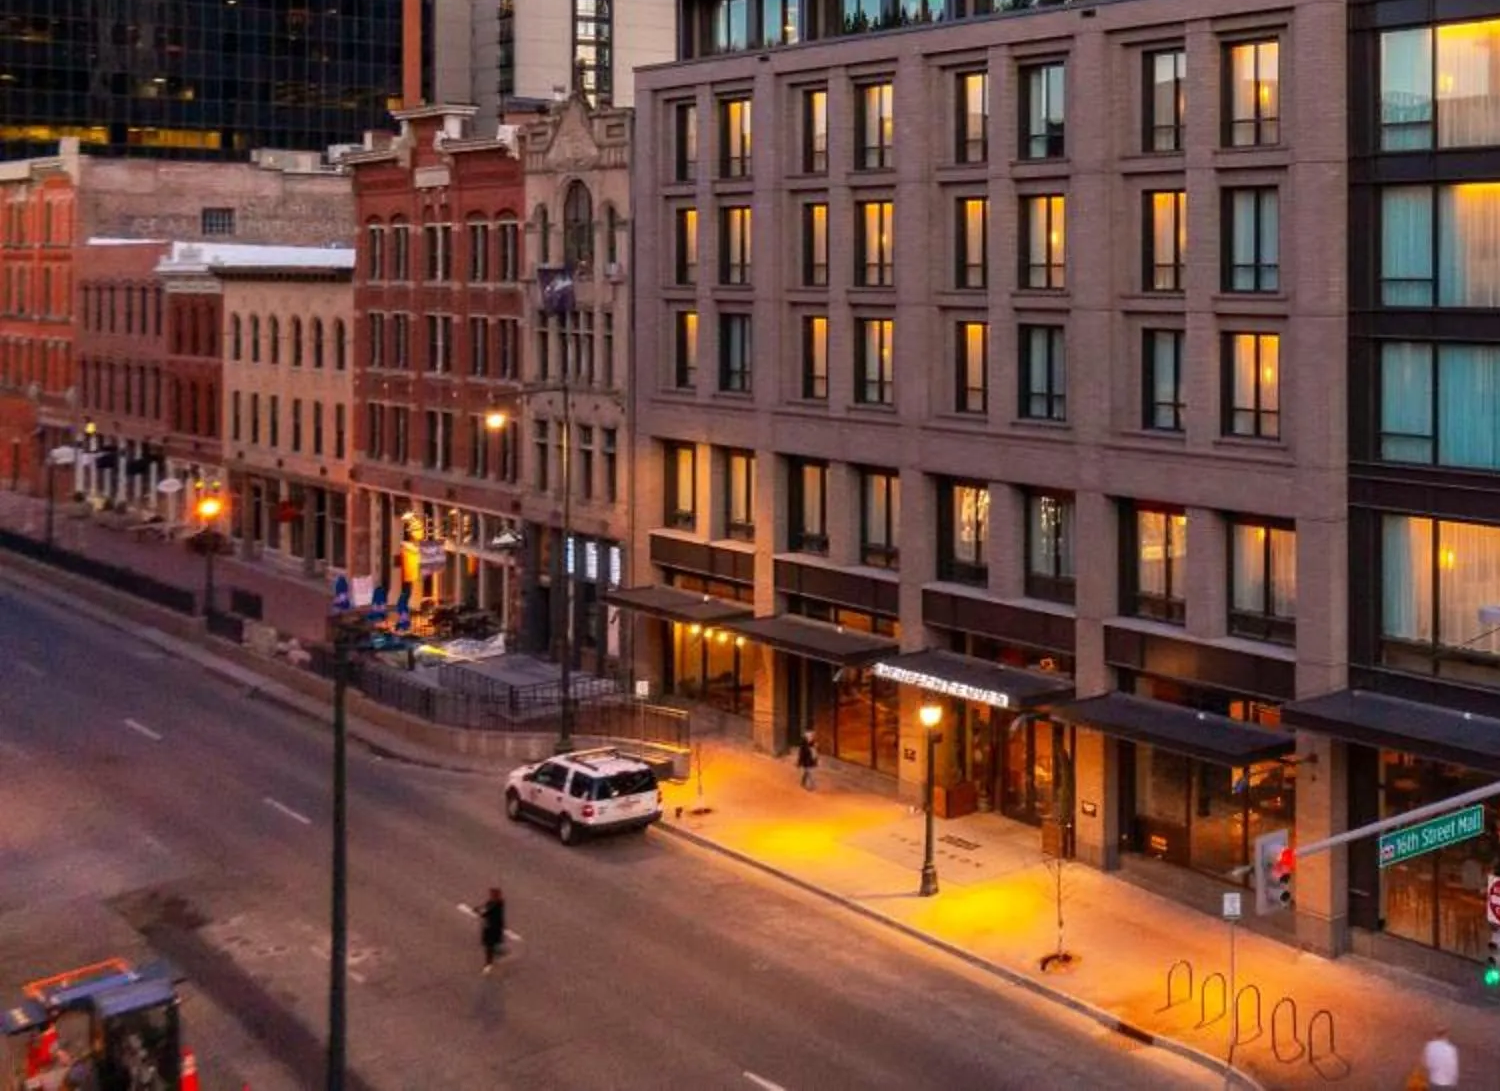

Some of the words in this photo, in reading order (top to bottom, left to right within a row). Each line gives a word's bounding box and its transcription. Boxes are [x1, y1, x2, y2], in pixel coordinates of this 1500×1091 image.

[1396, 831, 1419, 855] 16th
[1421, 820, 1455, 848] Street
[1458, 810, 1481, 835] Mall
